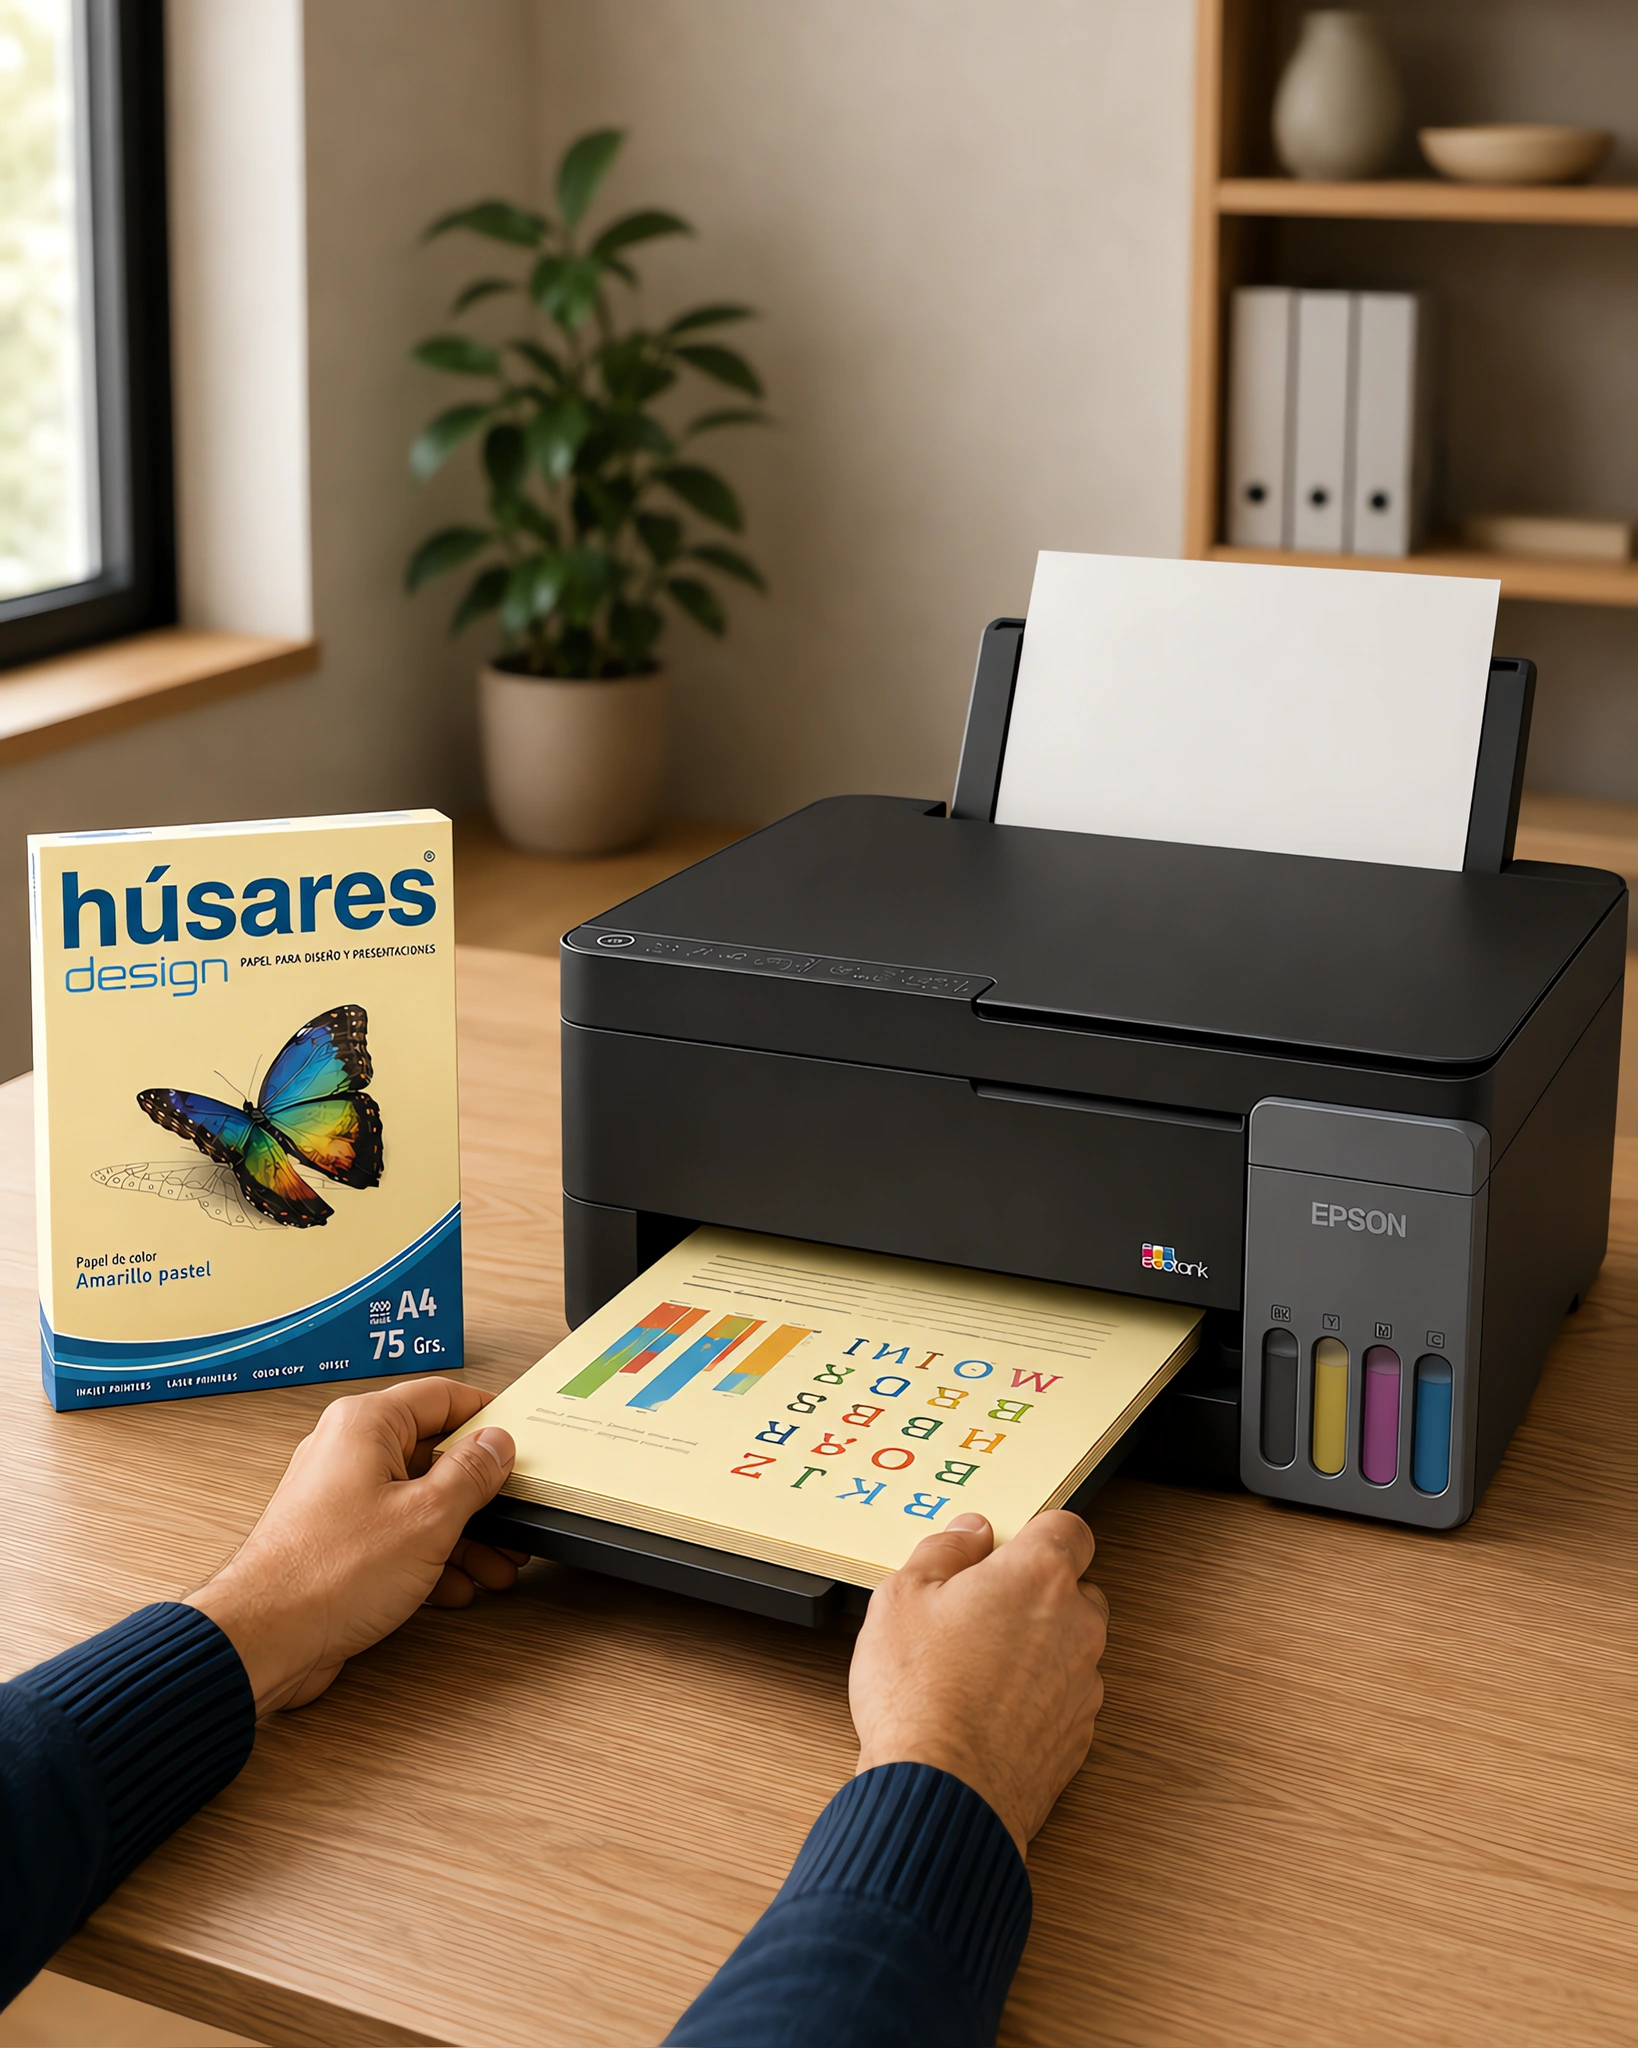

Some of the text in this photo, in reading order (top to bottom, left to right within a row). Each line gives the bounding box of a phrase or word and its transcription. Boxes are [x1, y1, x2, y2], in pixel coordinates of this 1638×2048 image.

[62, 865, 436, 949] húsares
[240, 956, 272, 967] PAPEL
[275, 953, 301, 965] PARA
[343, 949, 350, 960] Y
[353, 944, 436, 959] PRESENTACIONES
[65, 956, 228, 997] design
[1311, 1201, 1406, 1238] EPSON
[76, 1251, 157, 1270] Papel de color
[76, 1260, 211, 1289] Amarillo pastel
[396, 1288, 437, 1321] A4
[1328, 1315, 1336, 1327] Y
[1378, 1324, 1389, 1337] M
[369, 1329, 445, 1360] 75 Grs.
